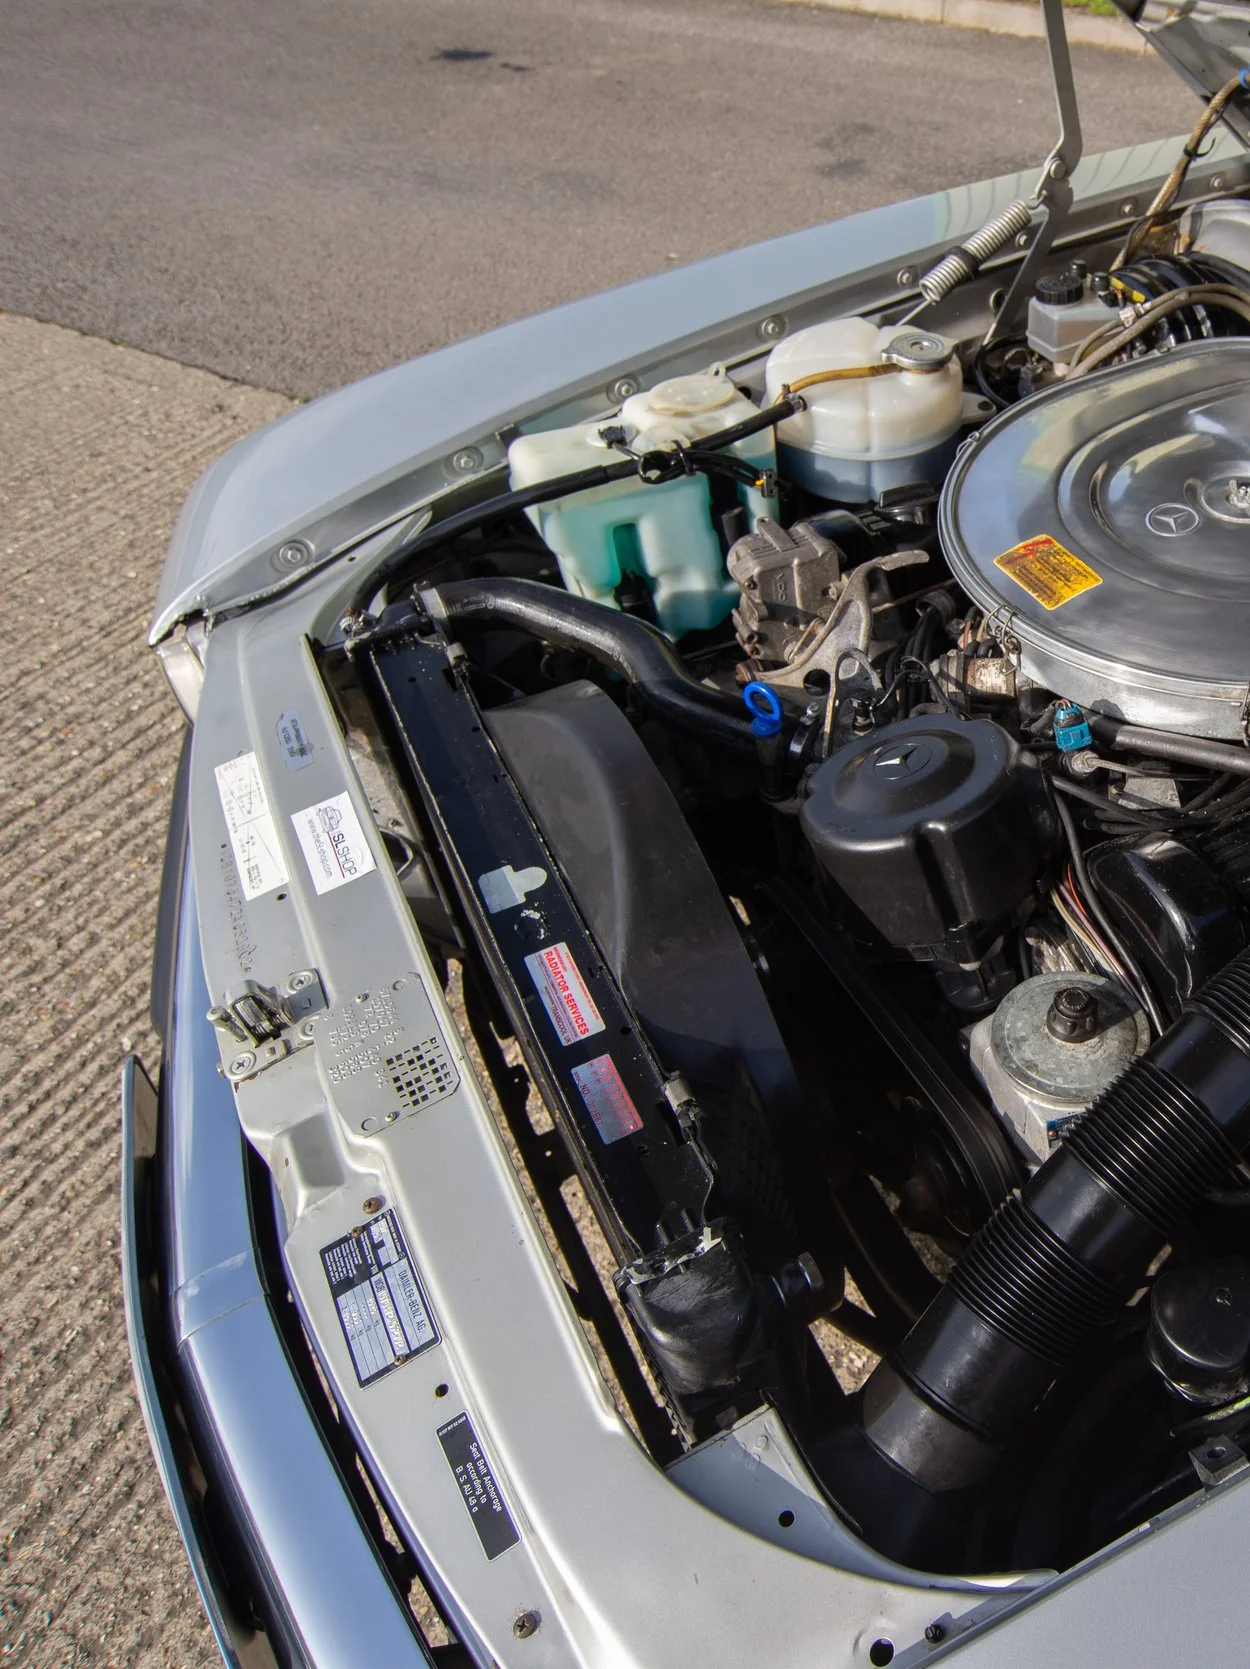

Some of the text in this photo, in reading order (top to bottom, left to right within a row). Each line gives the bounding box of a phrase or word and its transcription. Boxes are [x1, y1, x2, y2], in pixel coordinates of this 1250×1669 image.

[543, 949, 569, 993] RADIATOR
[562, 992, 589, 1035] SERVICES
[397, 1269, 428, 1333] DAIMLER-BENZ AG.
[455, 1465, 478, 1513] B. S. AU 48 a
[465, 1461, 487, 1503] according to
[468, 1442, 503, 1512] Seat Belt Anchorage
